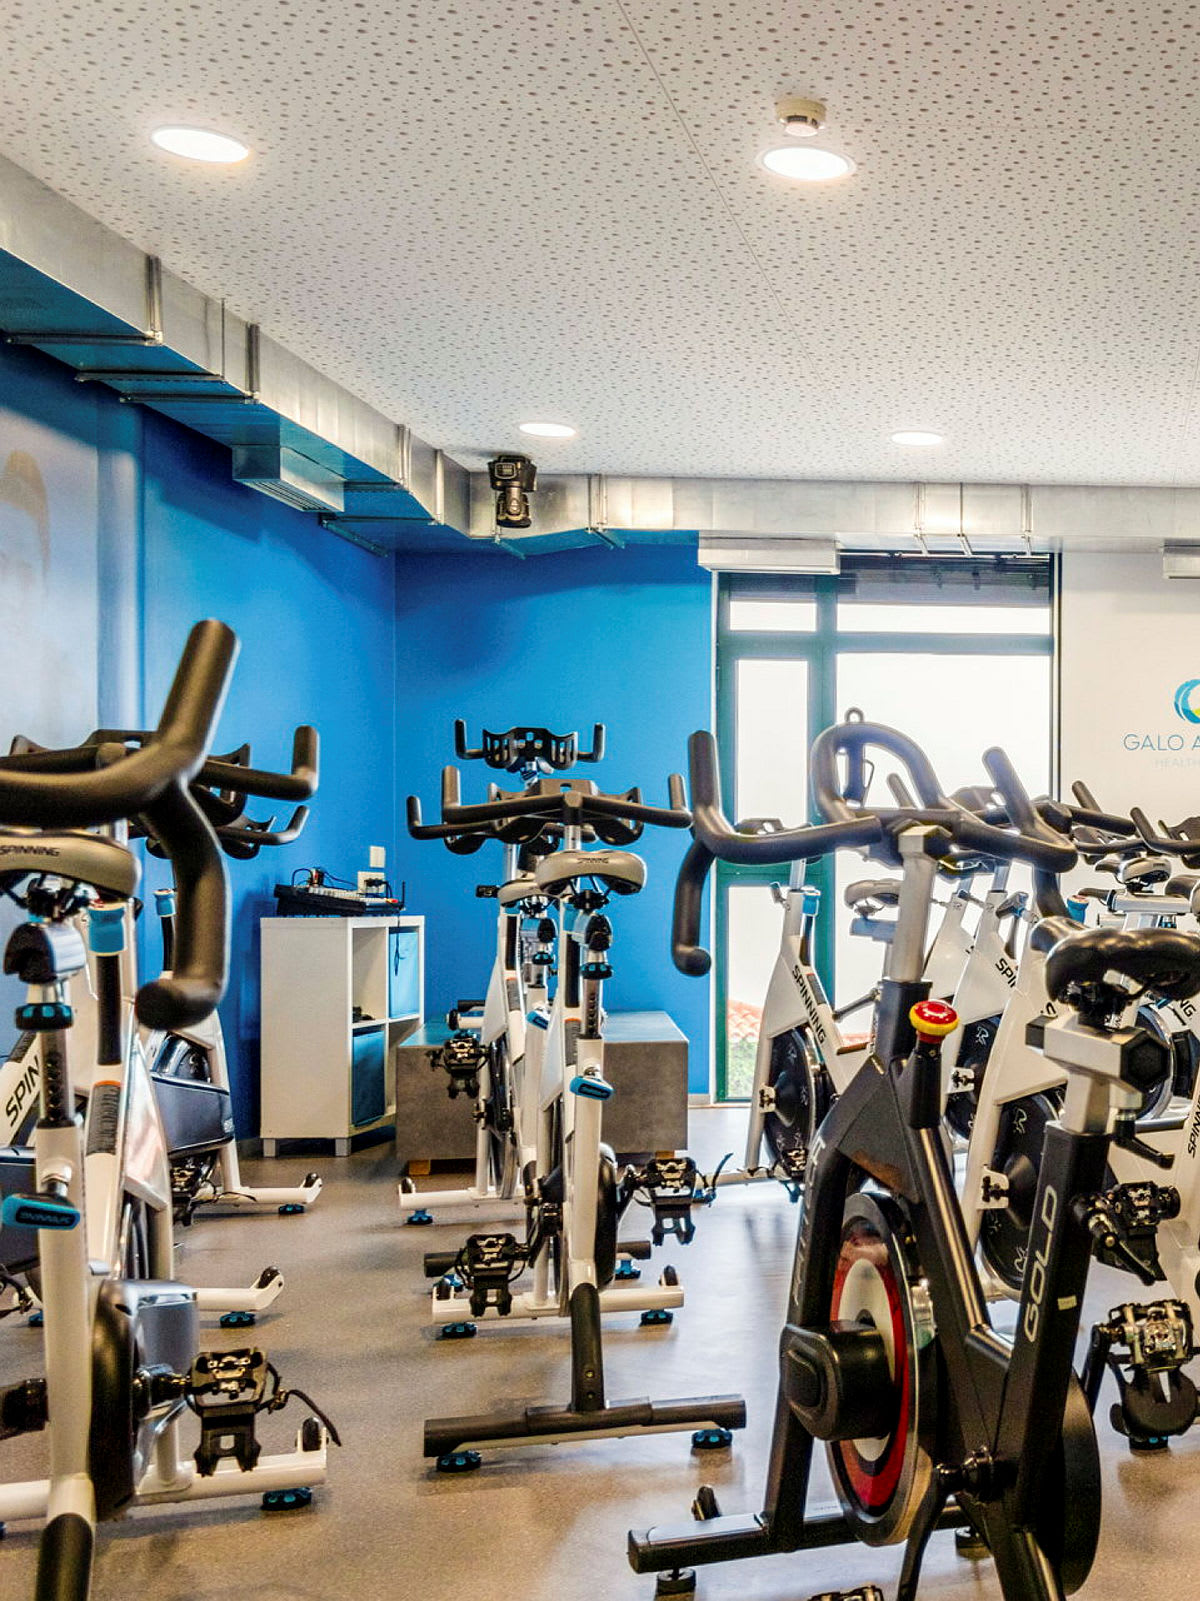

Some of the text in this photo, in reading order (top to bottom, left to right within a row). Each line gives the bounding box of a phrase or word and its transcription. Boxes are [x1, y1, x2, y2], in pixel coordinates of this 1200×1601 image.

[1123, 733, 1184, 751] GALO
[1155, 757, 1200, 768] HEALTH
[792, 965, 826, 1044] SPINNING
[1024, 1184, 1058, 1343] GOLD
